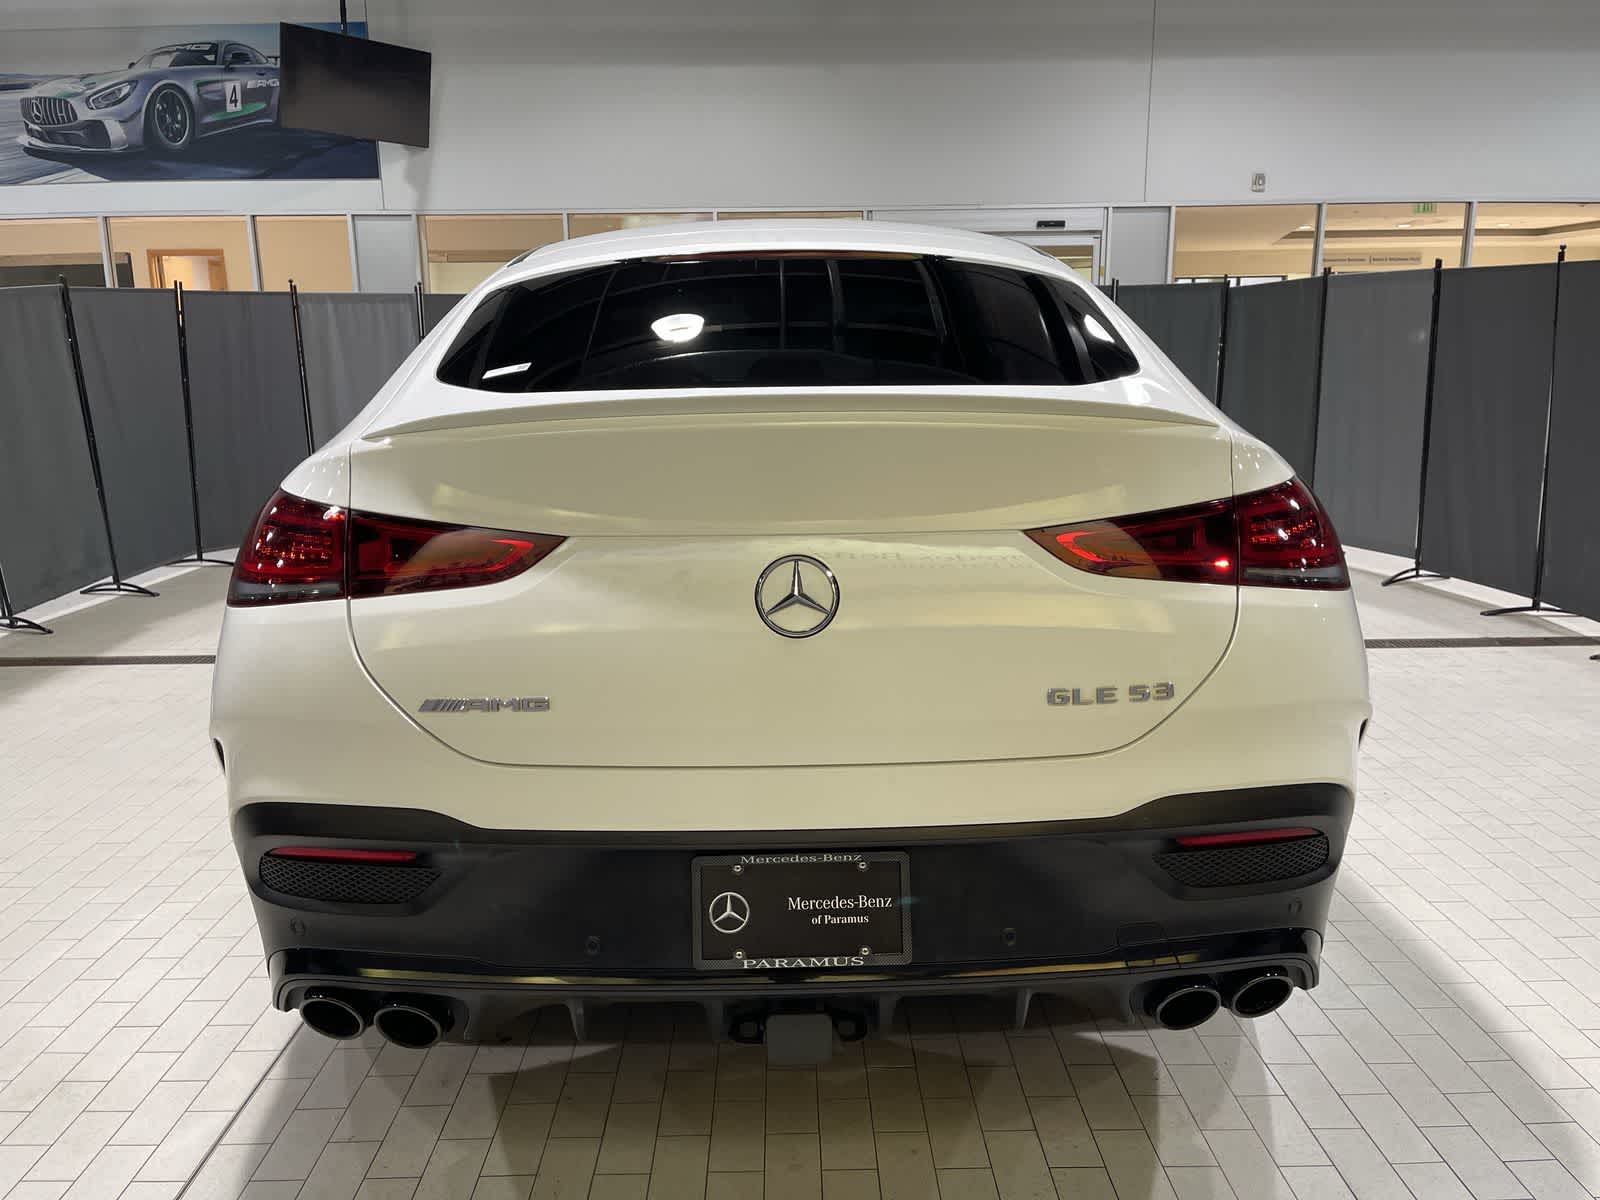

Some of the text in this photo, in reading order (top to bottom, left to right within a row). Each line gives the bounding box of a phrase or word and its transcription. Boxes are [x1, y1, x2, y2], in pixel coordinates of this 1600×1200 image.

[230, 85, 238, 107] 4
[1047, 681, 1175, 706] GLE 53
[462, 697, 551, 712] AMG
[740, 854, 863, 864] Mercedes-Benz
[788, 895, 893, 911] Mercedes-Benz
[811, 914, 869, 925] of Paramus
[743, 956, 864, 969] PARAMUS
